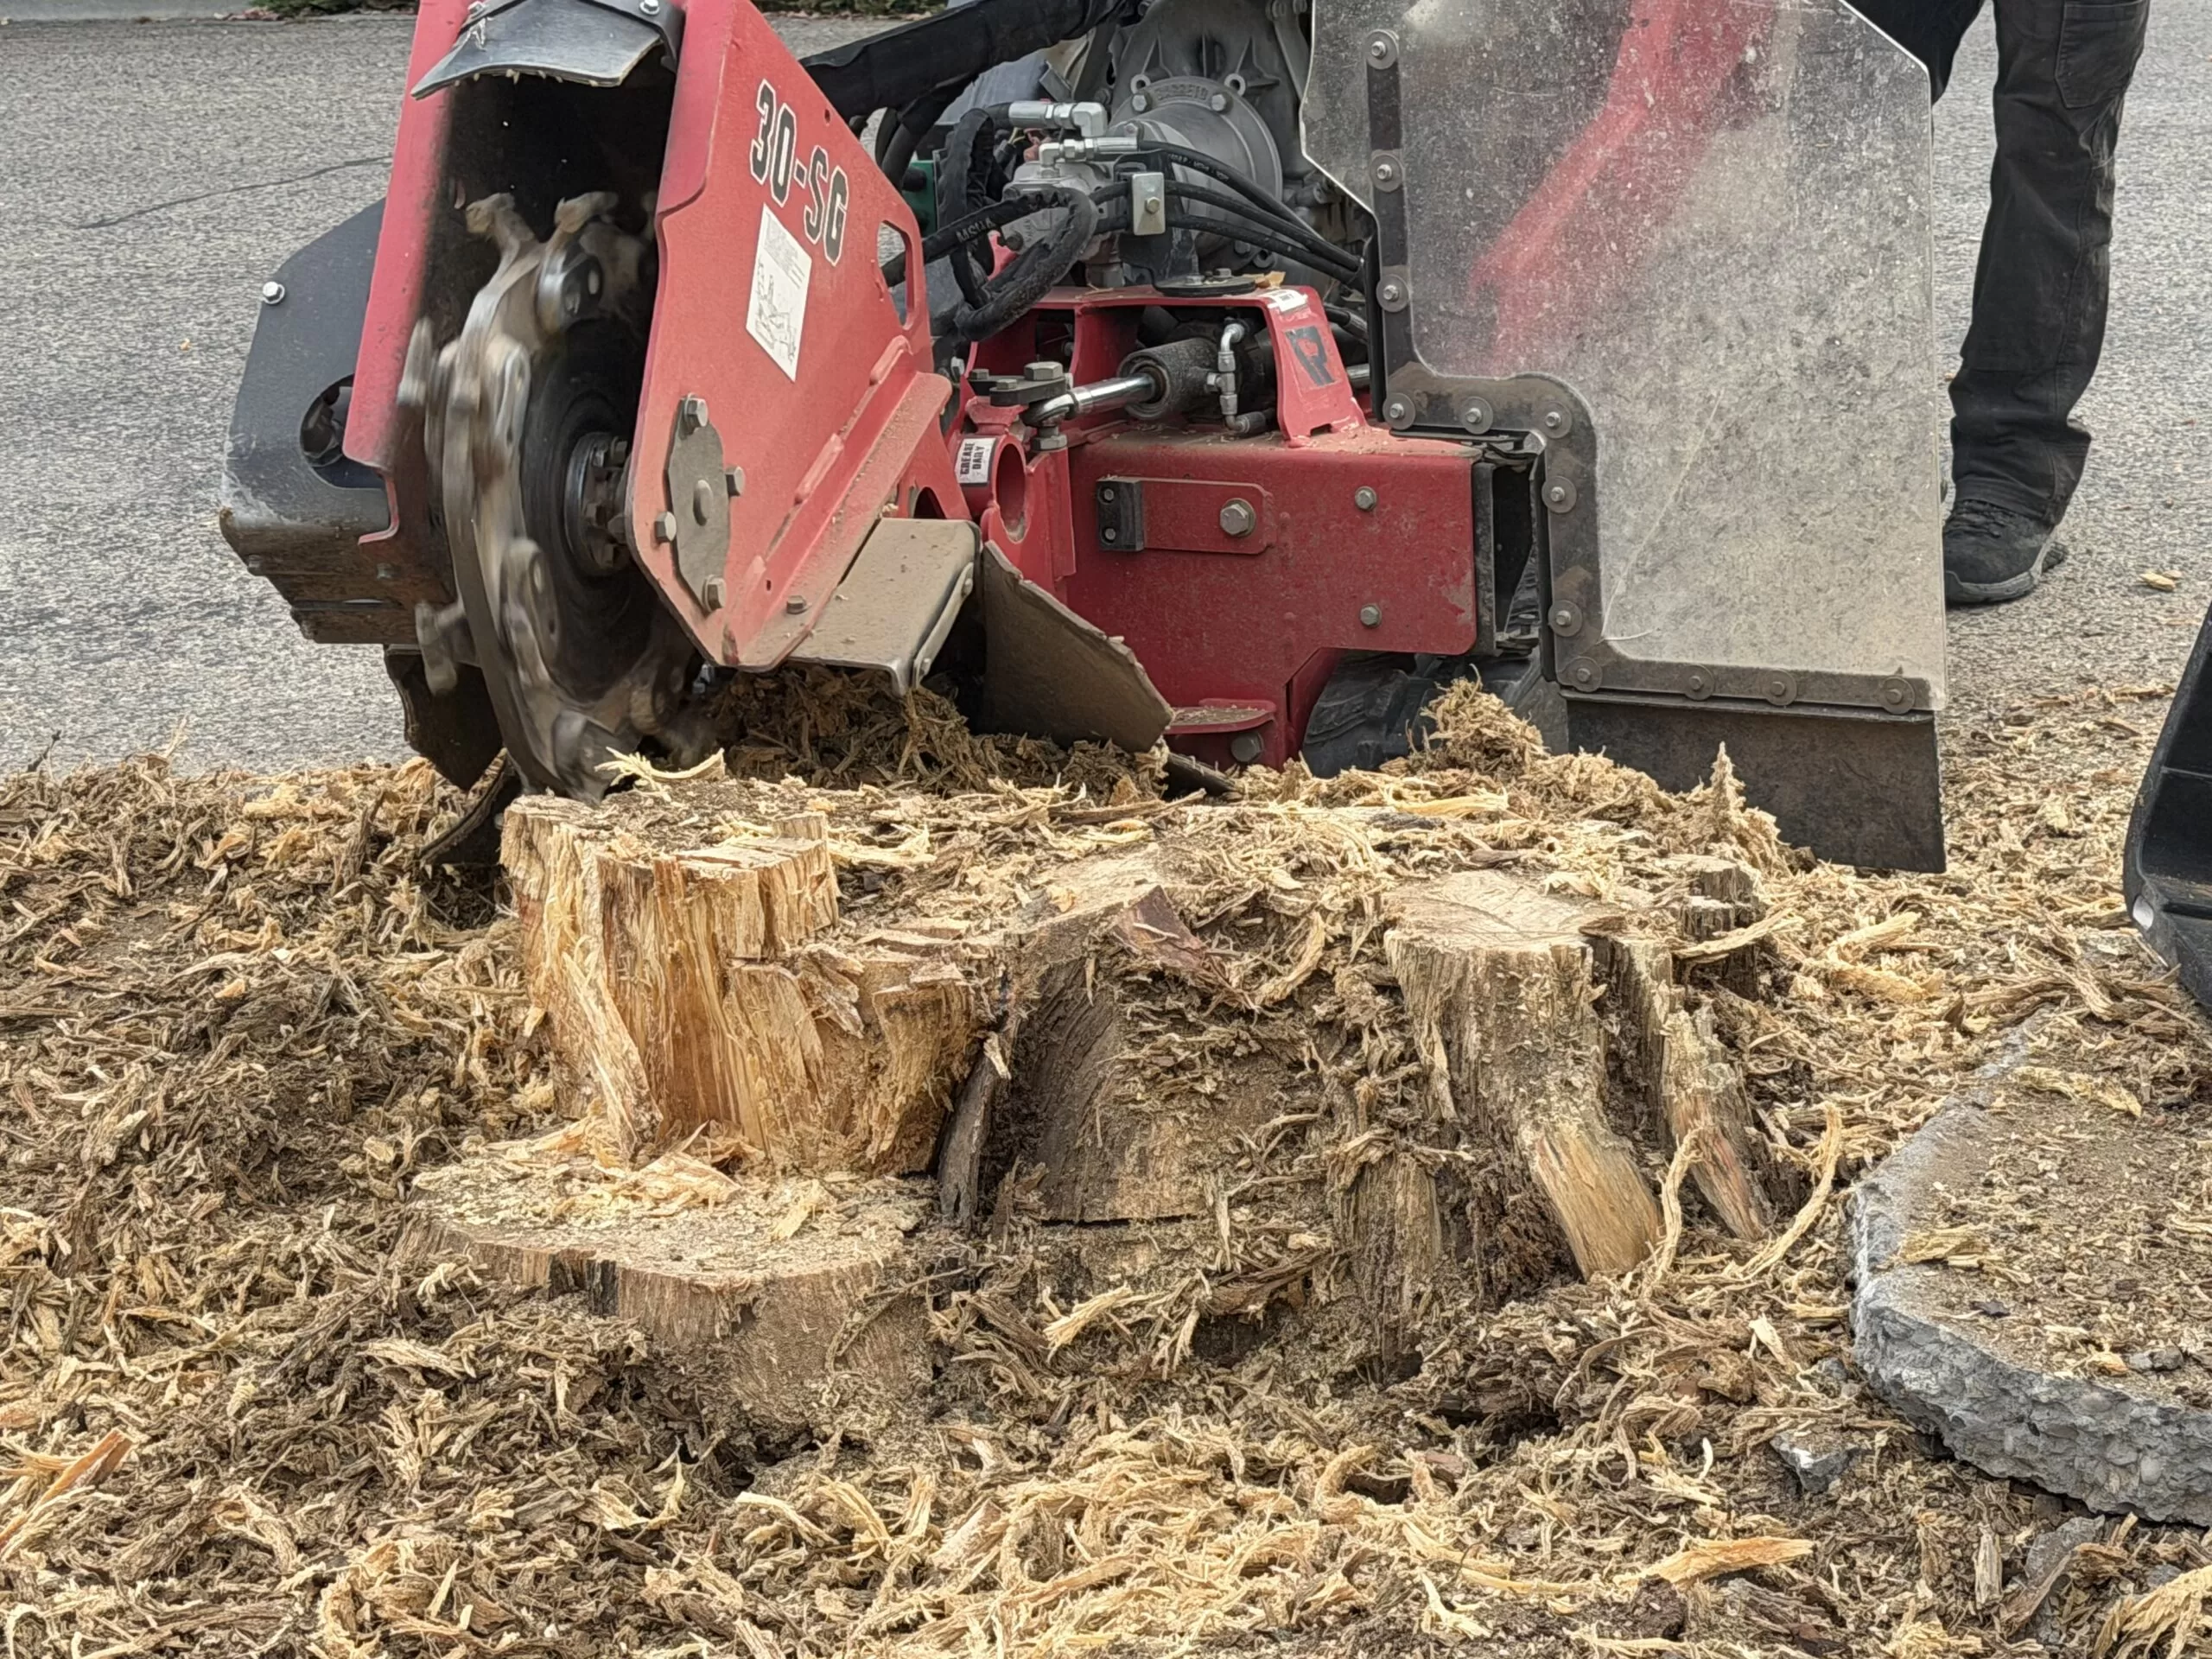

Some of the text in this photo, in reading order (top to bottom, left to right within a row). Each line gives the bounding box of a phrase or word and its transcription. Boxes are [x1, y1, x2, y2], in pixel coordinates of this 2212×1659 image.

[750, 79, 849, 266] 30-SG
[960, 442, 975, 475] GREASE
[972, 446, 985, 470] DAILY
